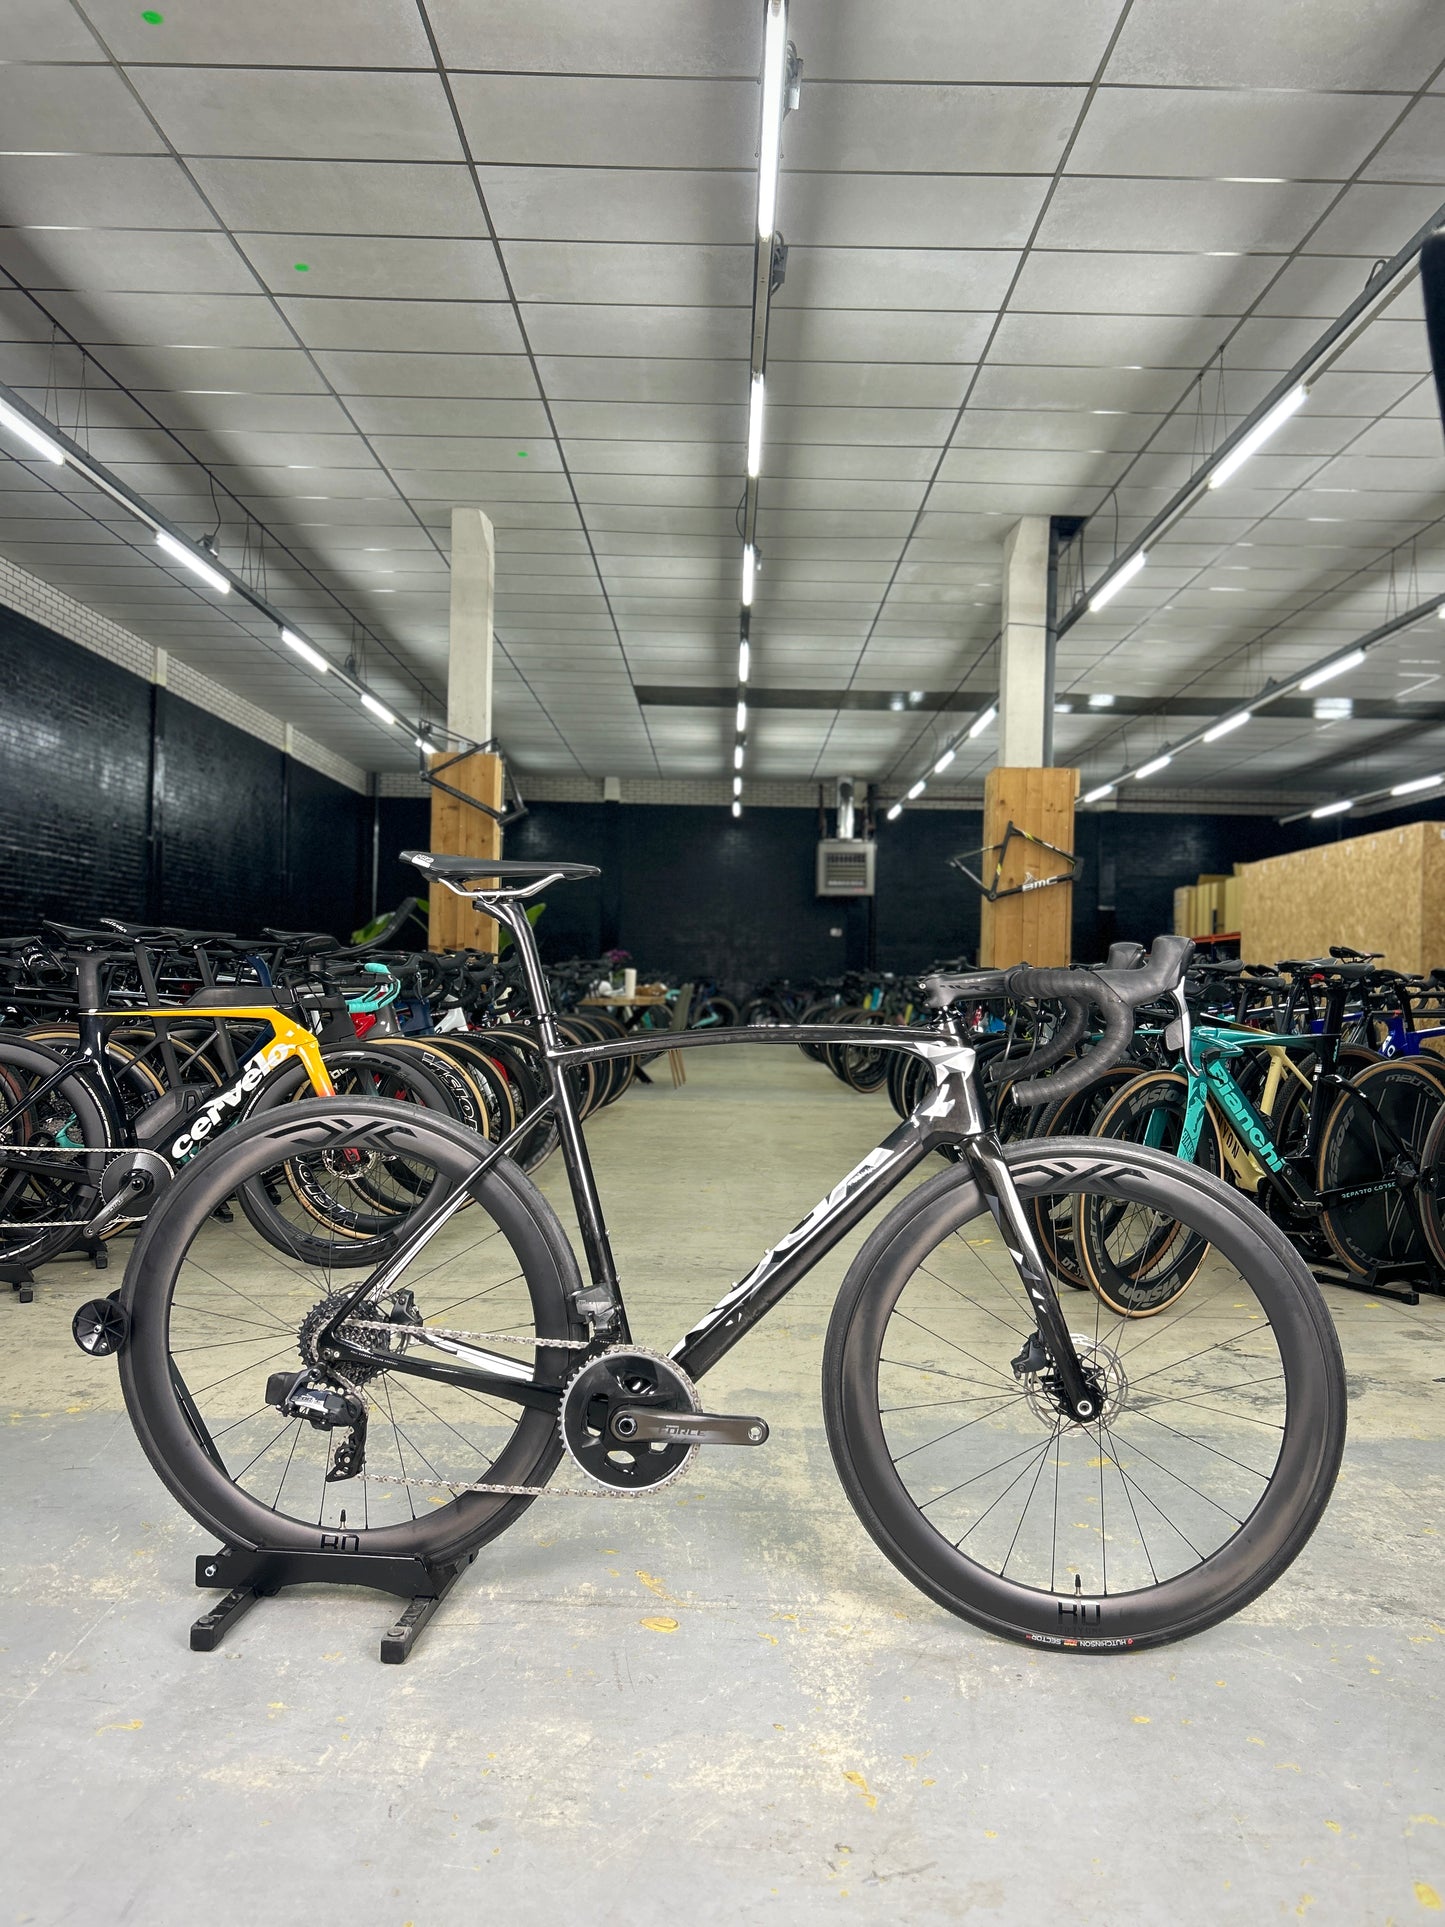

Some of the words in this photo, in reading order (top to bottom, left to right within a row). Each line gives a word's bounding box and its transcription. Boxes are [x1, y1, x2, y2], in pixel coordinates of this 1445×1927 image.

[1022, 876, 1058, 891] BMC
[1208, 1060, 1287, 1173] Bianchi
[1031, 1634, 1061, 1645] SECTOR
[1080, 1639, 1127, 1647] HUTCHINSON
